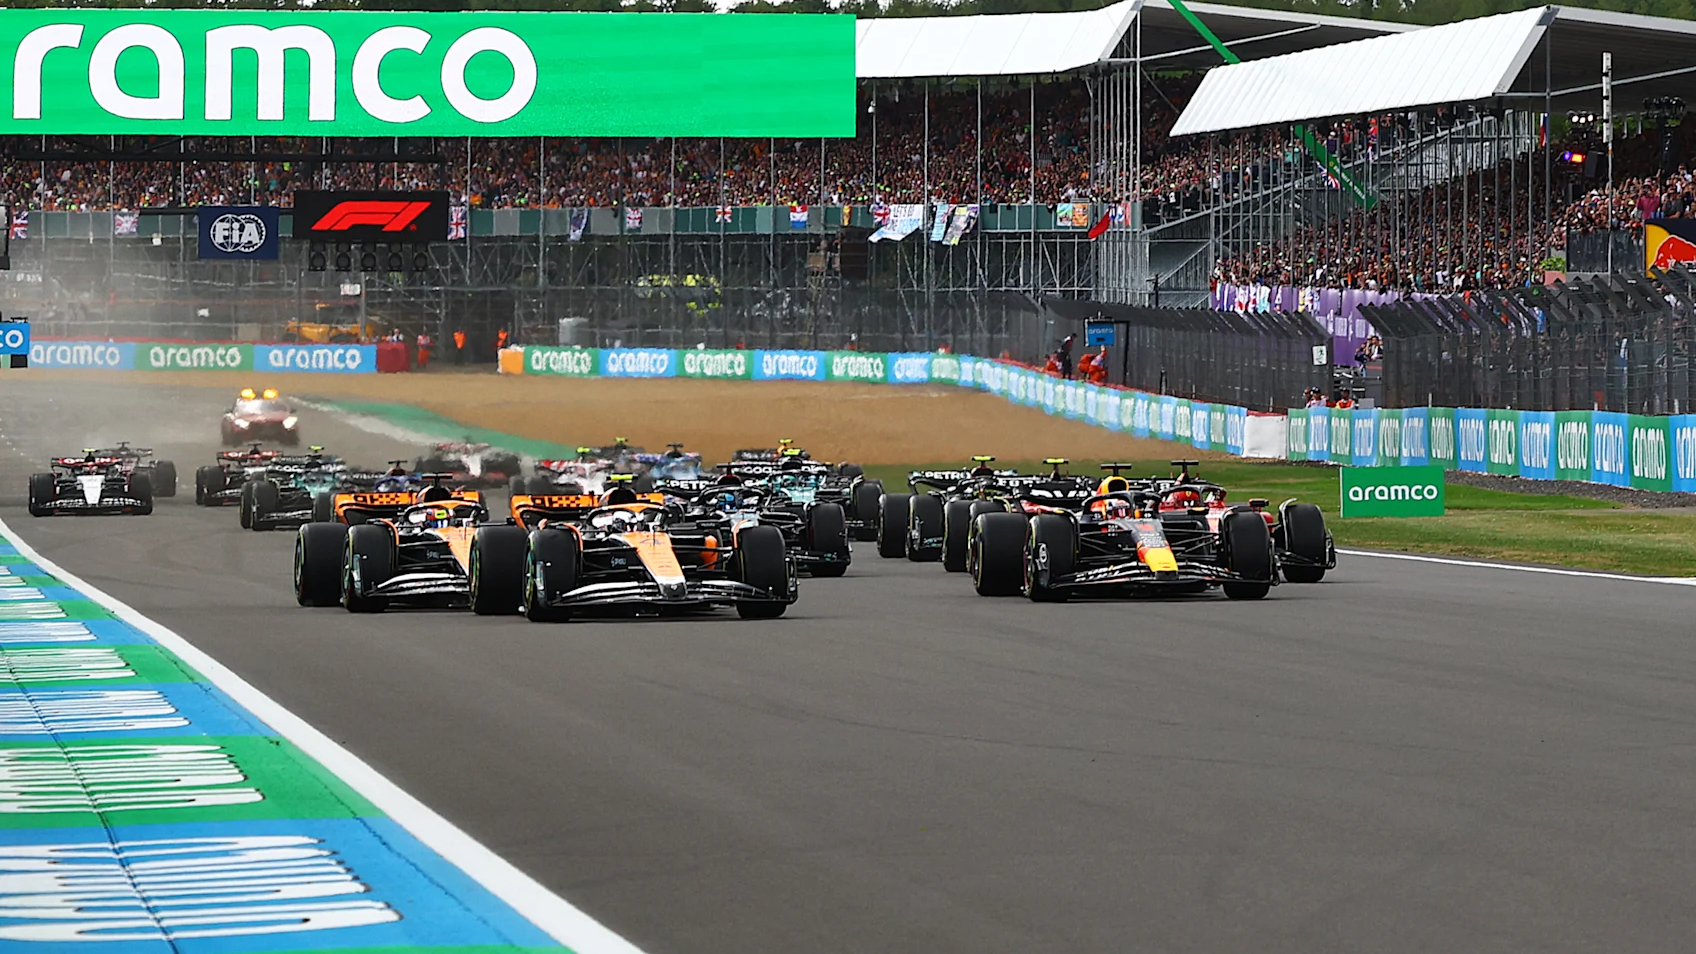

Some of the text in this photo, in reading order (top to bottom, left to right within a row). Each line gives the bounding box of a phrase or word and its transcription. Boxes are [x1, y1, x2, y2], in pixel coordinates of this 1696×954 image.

[31, 344, 120, 366] aramco
[149, 346, 242, 368] aramco
[268, 348, 362, 370] aramco
[531, 349, 592, 374] aramco
[607, 351, 669, 374] aramco
[684, 352, 746, 376] aramco
[762, 353, 818, 377] aramco
[1349, 484, 1438, 502] aramco
